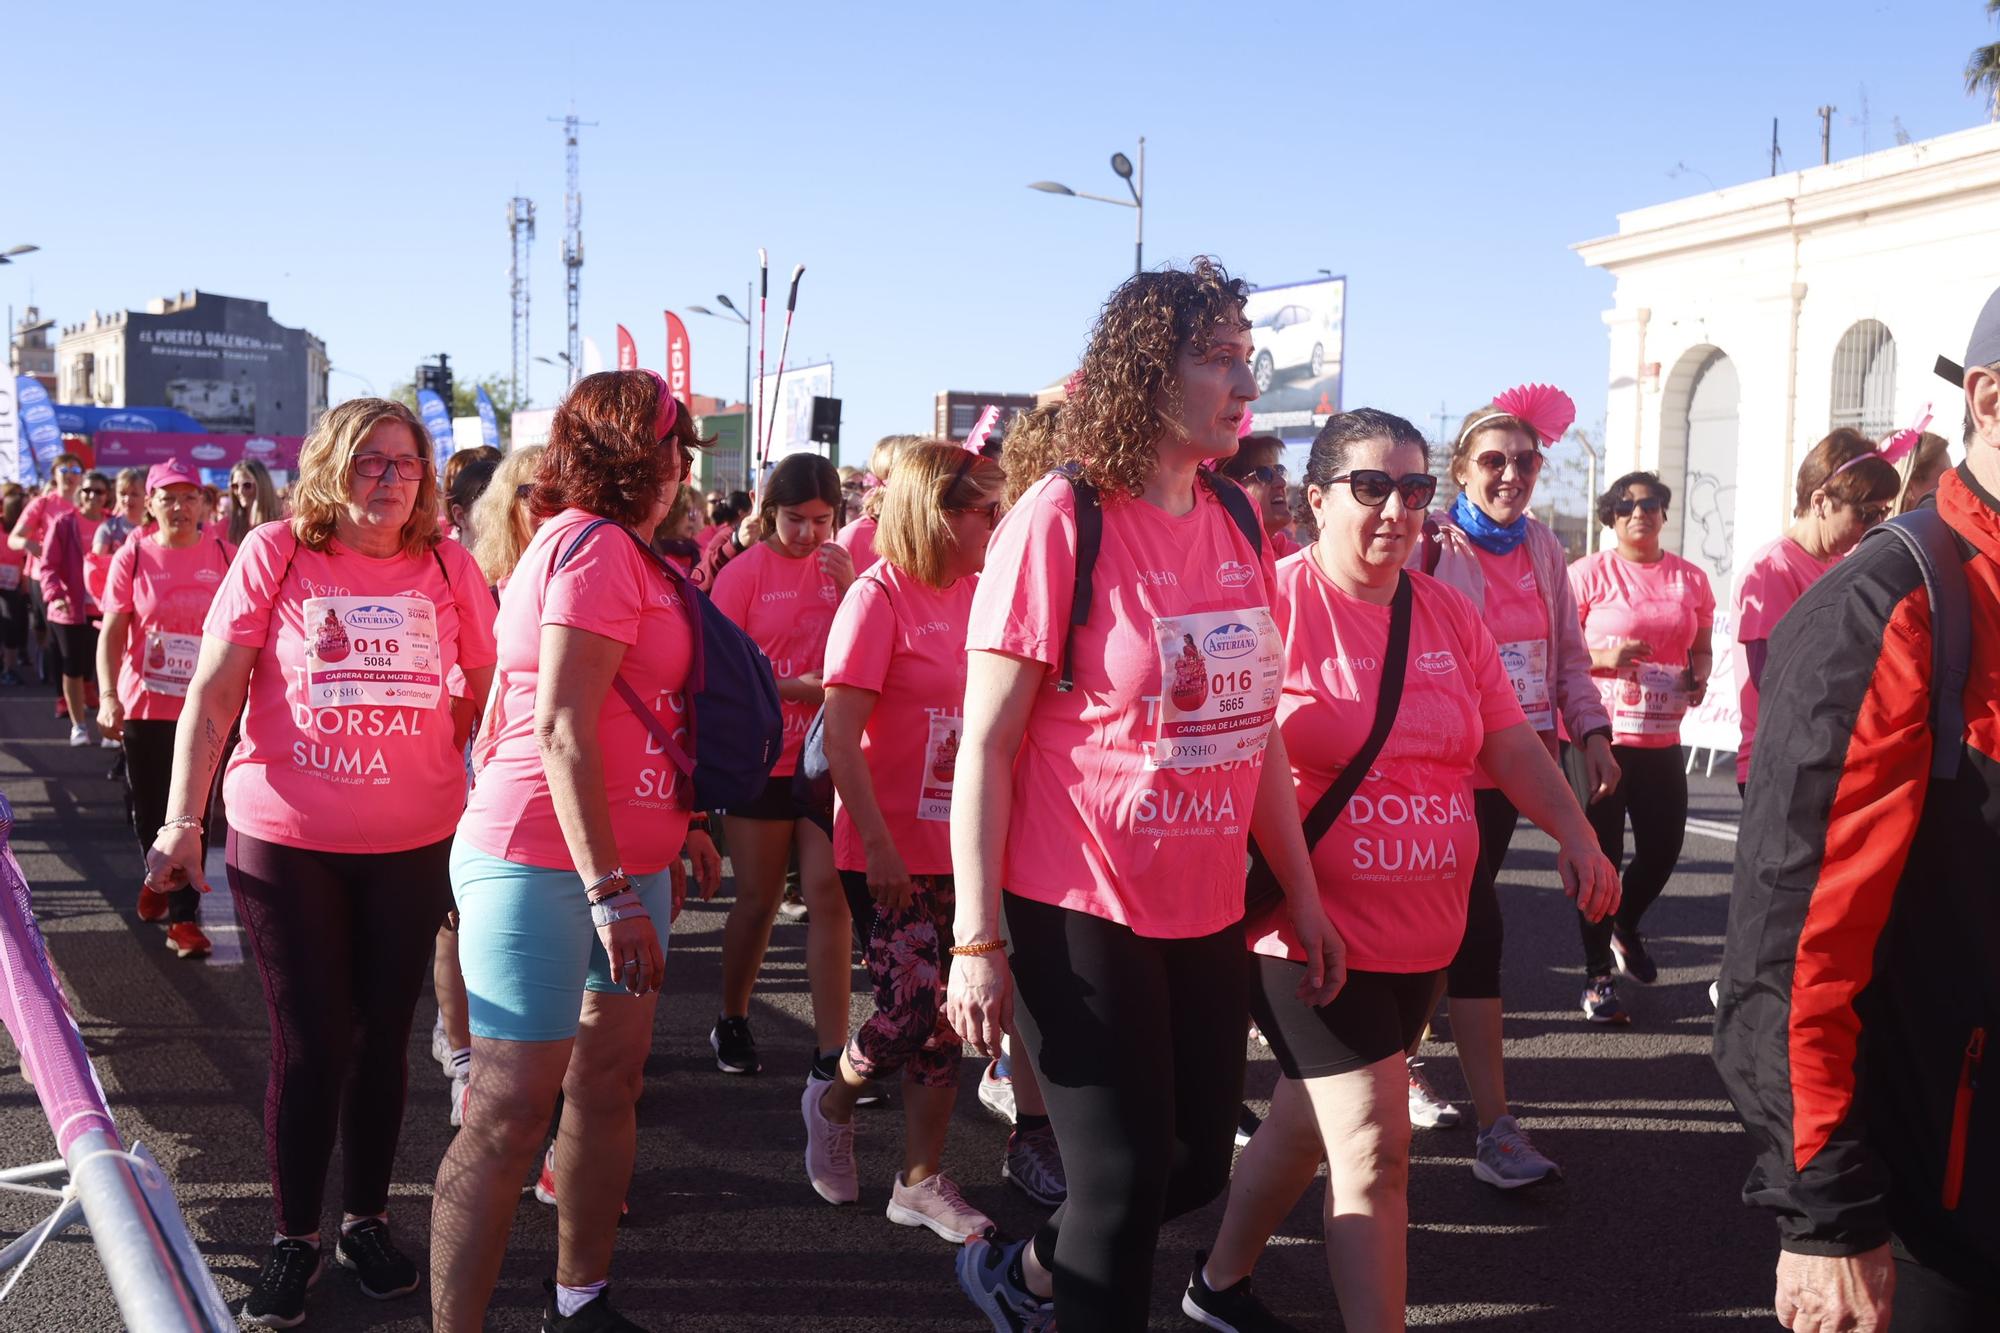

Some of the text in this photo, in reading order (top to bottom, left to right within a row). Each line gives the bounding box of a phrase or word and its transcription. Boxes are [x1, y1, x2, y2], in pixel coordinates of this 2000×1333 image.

[139, 330, 153, 342] EL
[155, 329, 202, 346] PUERTO
[301, 578, 351, 597] OYSHO
[761, 590, 798, 602] OYSHO
[350, 613, 399, 624] ASTURIANA
[353, 638, 400, 653] 016
[1209, 637, 1255, 653] ASTURIANA
[167, 657, 192, 669] 016
[364, 656, 392, 667] 5084
[325, 672, 361, 681] CARRERA
[1211, 669, 1252, 695] 016
[323, 687, 432, 700] OYSHO Santander
[1645, 691, 1668, 704] 016
[1219, 697, 1244, 713] 5665
[294, 703, 421, 737] DORSAL
[1176, 723, 1217, 734] CARRERA
[1218, 721, 1228, 730] DE
[1229, 720, 1238, 728] LA
[1239, 716, 1262, 726] MUJER
[293, 740, 388, 776] SUMA
[1171, 743, 1217, 758] OYSHO
[635, 768, 678, 800] SU
[1135, 788, 1237, 824] SUMA
[1350, 793, 1472, 826] DORSAL
[1352, 837, 1458, 870] SUMA
